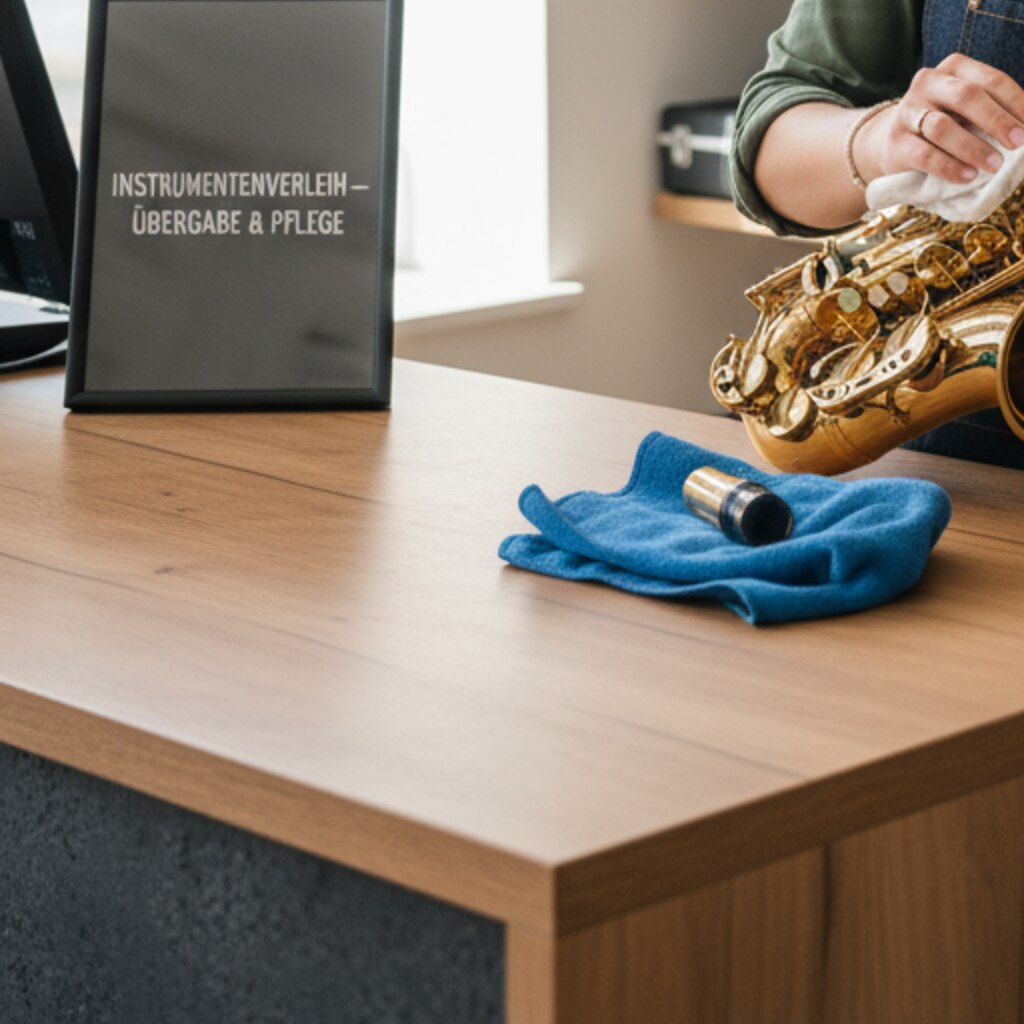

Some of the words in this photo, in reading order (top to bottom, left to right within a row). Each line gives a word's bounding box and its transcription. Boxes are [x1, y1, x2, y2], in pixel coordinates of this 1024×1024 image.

[111, 172, 347, 197] INSTRUMENTENVERLEIH
[132, 204, 242, 235] ÜBERGABE
[248, 210, 264, 235] &
[271, 209, 345, 235] PFLEGE
